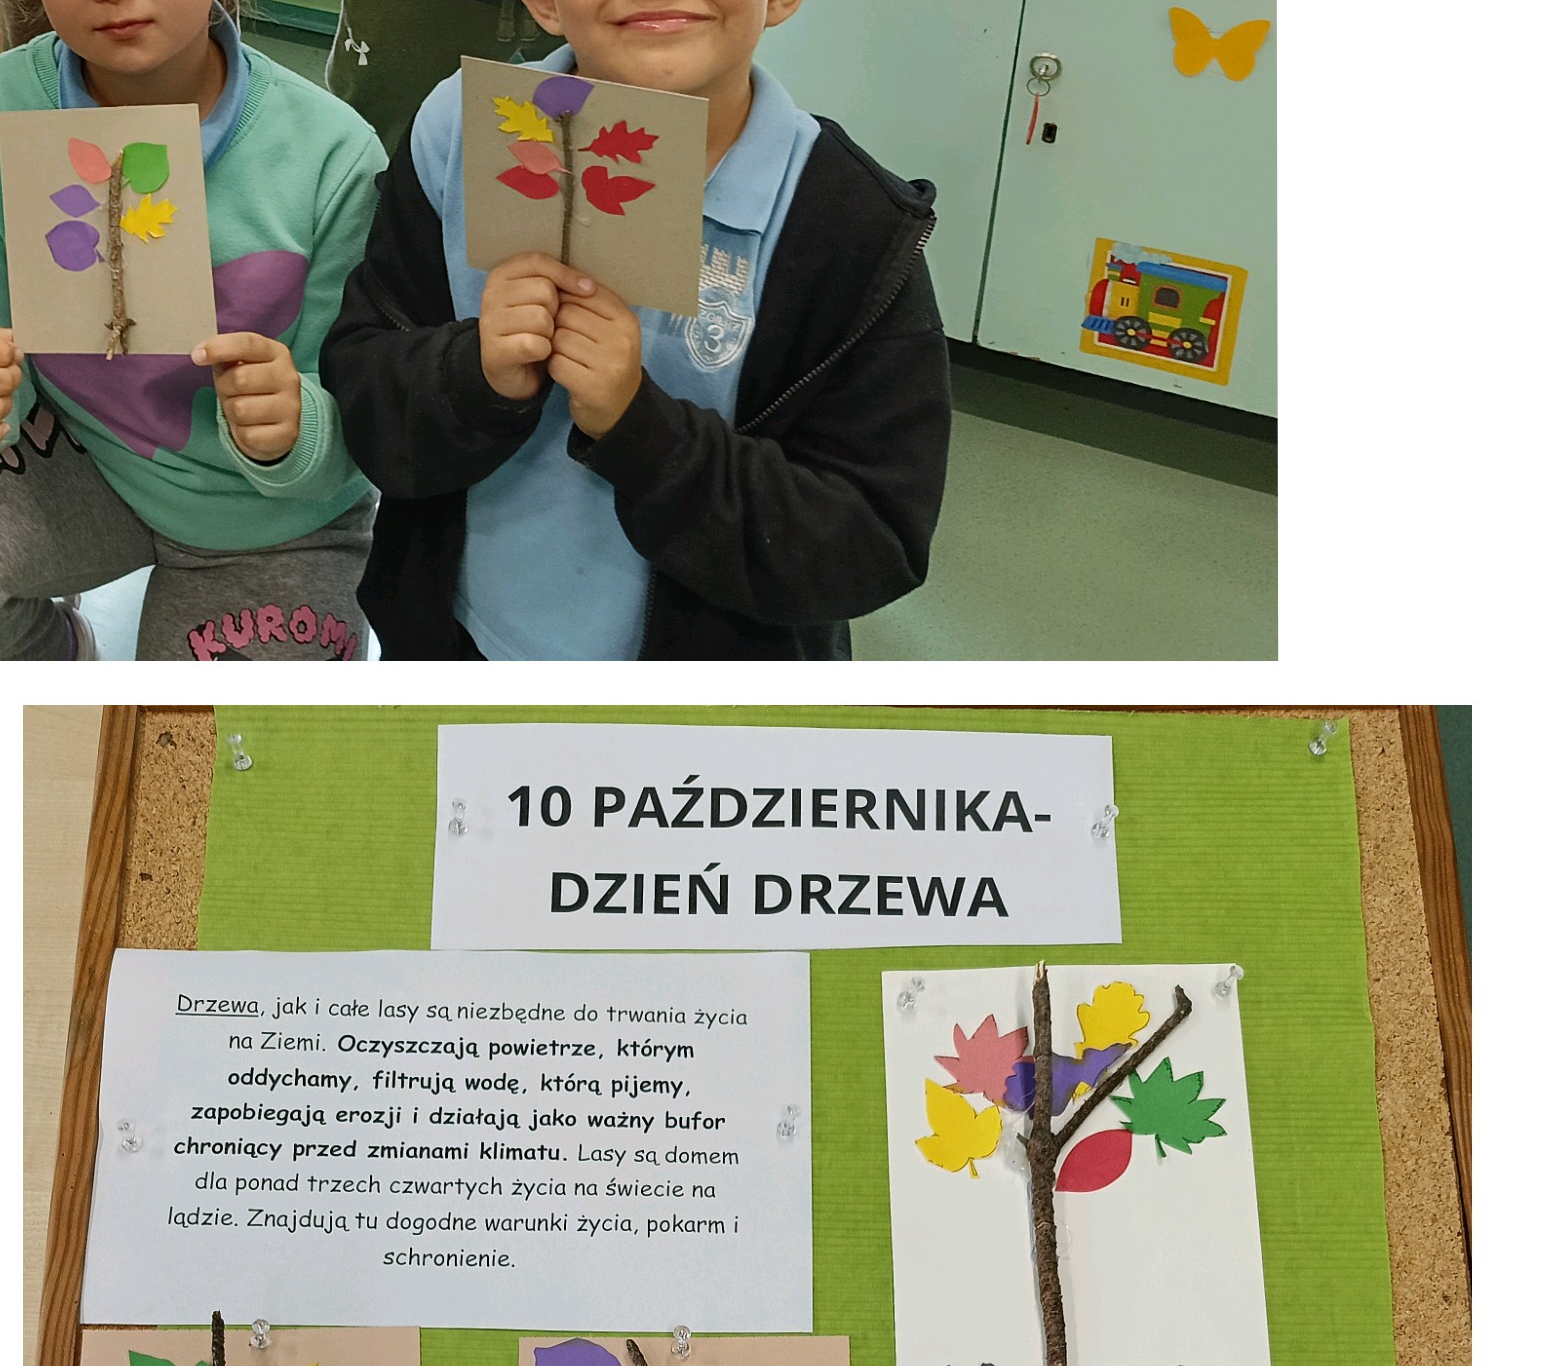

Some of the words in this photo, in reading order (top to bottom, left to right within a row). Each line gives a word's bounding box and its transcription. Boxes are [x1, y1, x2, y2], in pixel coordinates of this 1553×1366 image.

[703, 324, 725, 354] 3
[188, 603, 358, 661] KUROMI
[508, 785, 572, 827] 10
[594, 774, 1051, 833] PAŹDZIERNIKA-
[551, 862, 729, 915] DZIEŃ
[755, 874, 1009, 917] DRZEWA
[175, 993, 265, 1018] Drzewa,
[271, 996, 307, 1020] jak
[315, 998, 320, 1015] i
[329, 999, 370, 1017] całe
[379, 999, 419, 1024] lasy
[426, 1005, 453, 1022] są
[457, 1002, 565, 1024] niezbędne
[573, 1003, 598, 1022] do
[607, 1006, 686, 1024] trwania
[694, 1009, 747, 1030] życia
[229, 1035, 253, 1049] na
[260, 1031, 326, 1052] Ziemi.
[337, 1034, 480, 1060] Oczyszczają
[489, 1038, 603, 1061] powietrze,
[617, 1038, 694, 1063] którym
[228, 1067, 359, 1093] oddychamy,
[372, 1070, 457, 1095] filtrują
[465, 1072, 527, 1095] wodę,
[541, 1073, 603, 1096] którą
[611, 1075, 690, 1099] pijemy,
[191, 1102, 327, 1127] zapobiegają
[335, 1106, 402, 1129] erozji
[413, 1107, 419, 1124] i
[429, 1106, 521, 1131] działają
[528, 1108, 577, 1131] jako
[587, 1111, 655, 1134] ważny
[665, 1111, 725, 1131] bufor
[174, 1136, 283, 1161] chroniący
[293, 1139, 357, 1162] przed
[367, 1141, 469, 1160] zmianami
[479, 1141, 567, 1161] klimatu.
[578, 1143, 627, 1167] Lasy
[633, 1149, 660, 1166] są
[665, 1145, 739, 1165] domem
[195, 1171, 227, 1190] dla
[235, 1173, 299, 1196] ponad
[307, 1174, 381, 1193] trzech
[389, 1176, 502, 1201] czwartych
[511, 1178, 567, 1201] życia
[574, 1182, 598, 1196] na
[605, 1177, 684, 1197] świecie
[692, 1185, 716, 1198] na
[168, 1206, 238, 1228] lądzie.
[247, 1208, 350, 1234] Znajdują
[355, 1212, 377, 1230] tu
[386, 1211, 477, 1236] dogodne
[485, 1212, 568, 1232] warunki
[577, 1213, 639, 1237] życia,
[647, 1213, 725, 1238] pokarm
[734, 1216, 739, 1233] i
[383, 1247, 515, 1268] schronienie.
